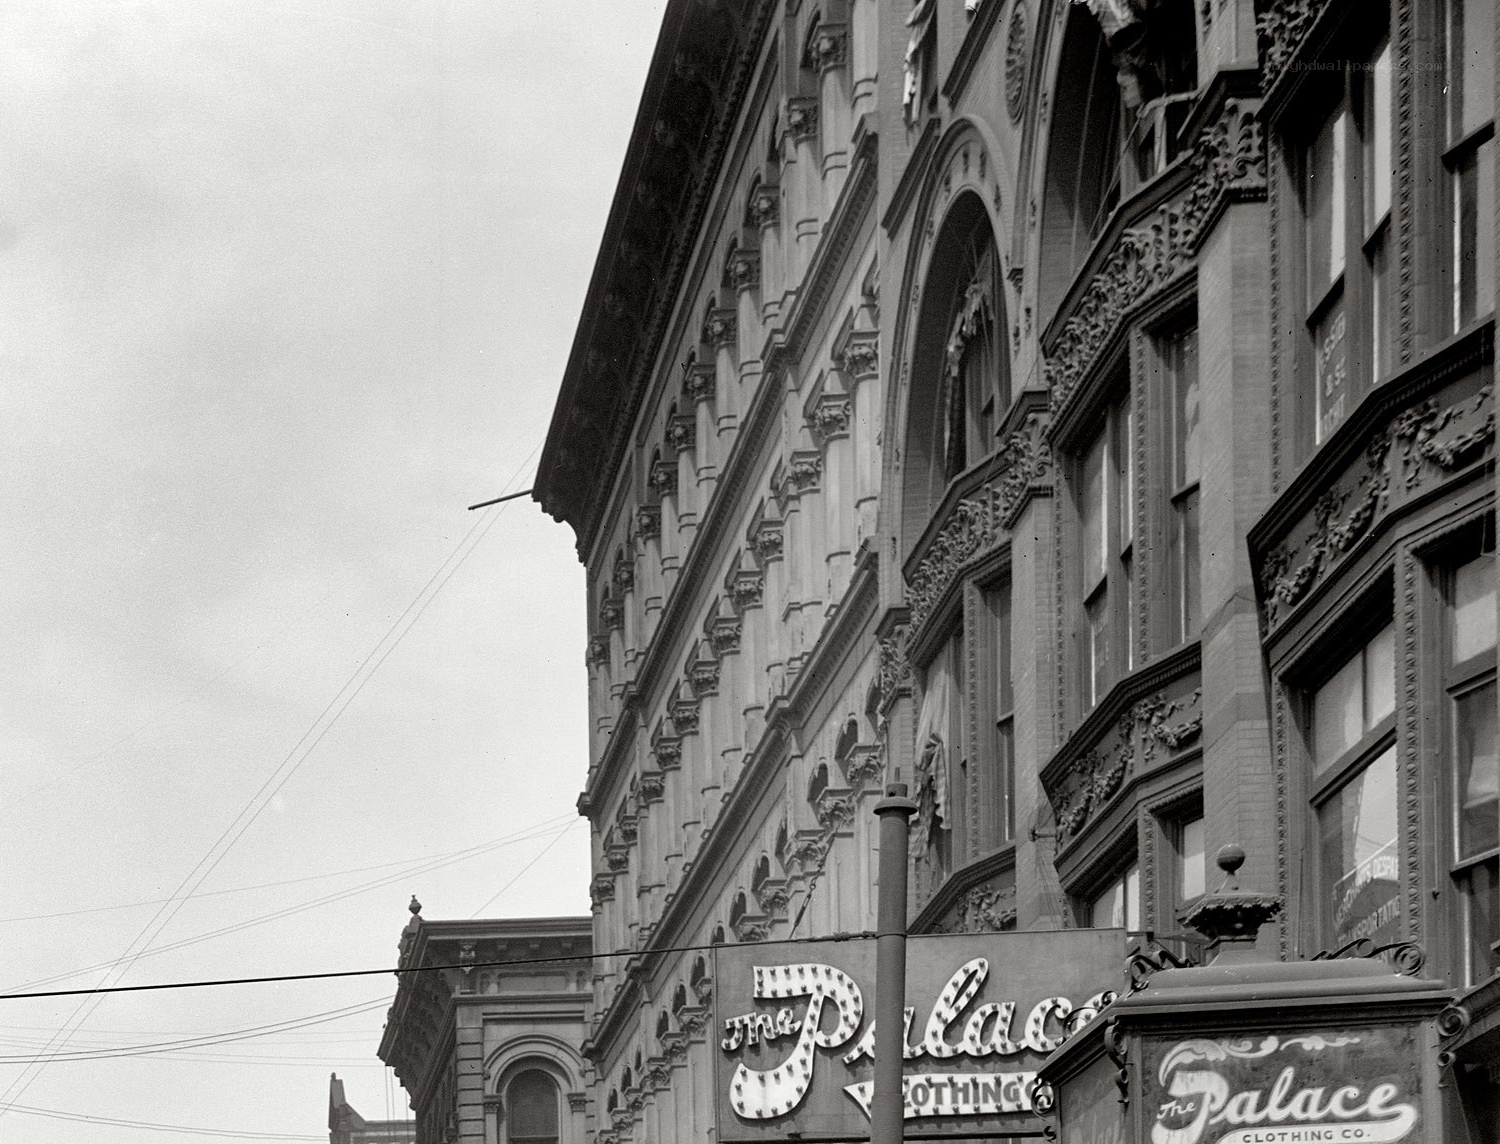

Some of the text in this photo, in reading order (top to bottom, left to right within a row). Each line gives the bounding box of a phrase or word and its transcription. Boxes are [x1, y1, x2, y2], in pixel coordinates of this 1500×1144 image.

[723, 1008, 804, 1054] The
[1157, 1098, 1198, 1121] The
[1341, 1127, 1372, 1142] CO.
